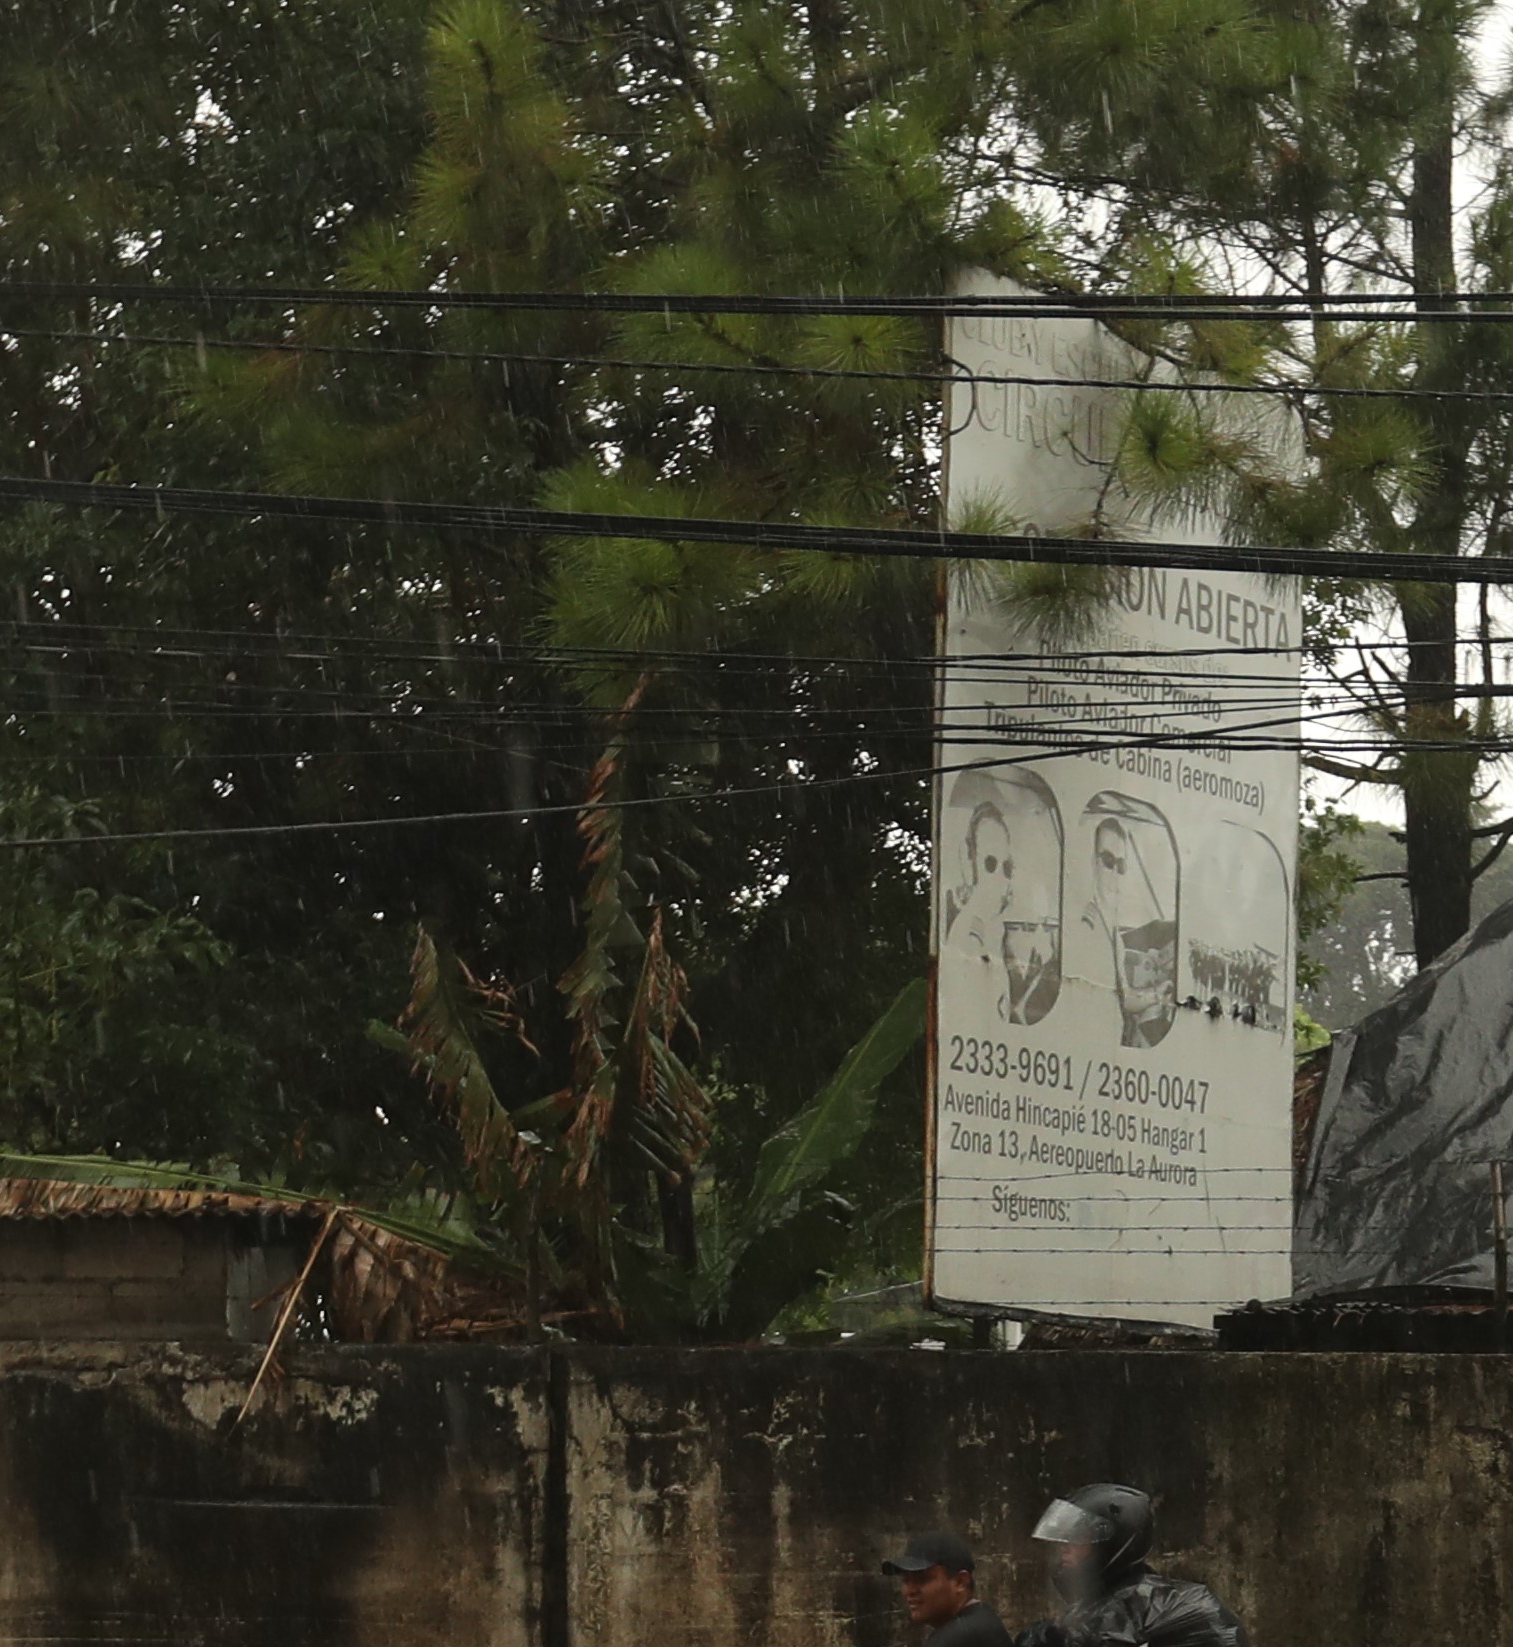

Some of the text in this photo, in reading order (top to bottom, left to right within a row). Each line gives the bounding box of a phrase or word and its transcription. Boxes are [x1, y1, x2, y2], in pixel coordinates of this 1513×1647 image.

[1174, 576, 1292, 663] ABIERTA
[1027, 675, 1078, 719] Piloto
[1115, 738, 1172, 782] Cabina
[1176, 756, 1266, 816] (aeromoza)
[949, 1034, 1210, 1115] 2333-9691 / 2360-0047
[943, 1083, 1208, 1156] Avenida Hincapié 18-05 Hangar 1
[949, 1121, 1198, 1187] Zona 13, Aereopuerto La Aurora
[991, 1184, 1071, 1223] Síguenos:
